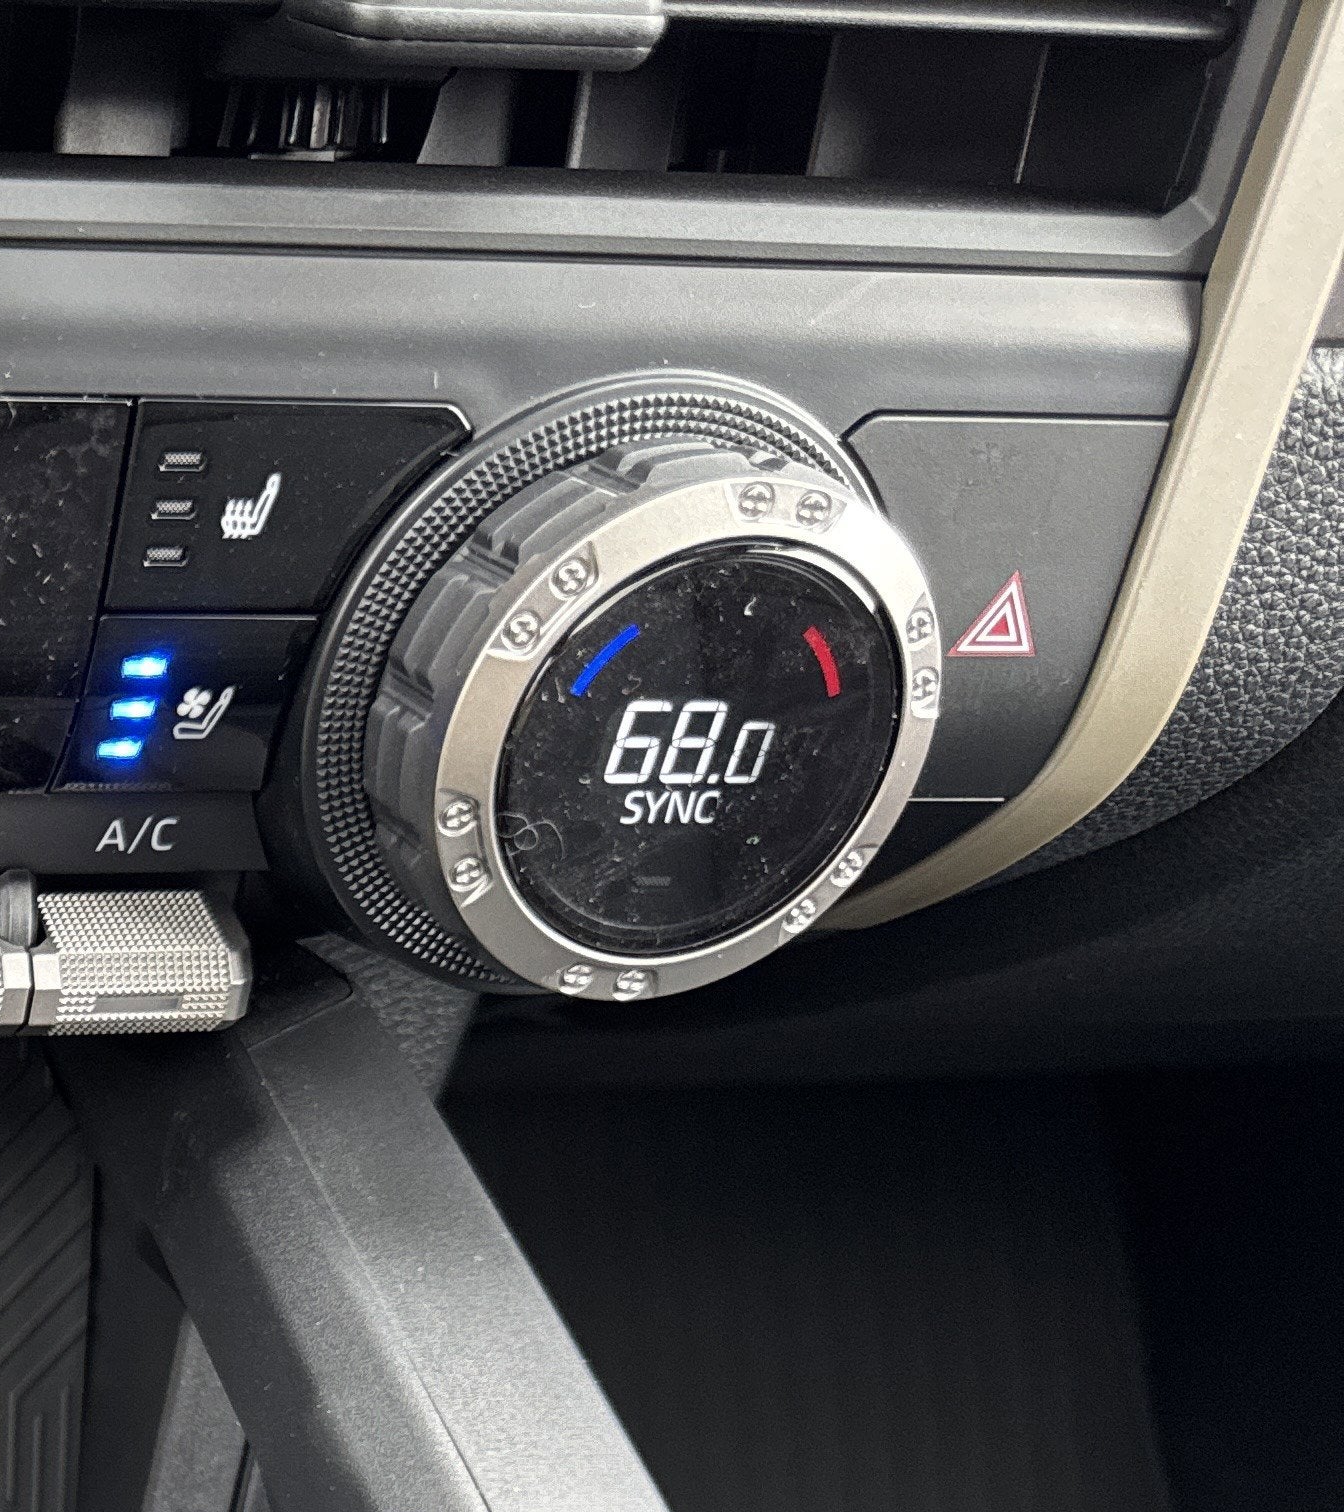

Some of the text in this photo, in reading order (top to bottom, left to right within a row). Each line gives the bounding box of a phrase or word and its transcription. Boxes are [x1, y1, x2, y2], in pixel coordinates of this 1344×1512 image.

[603, 700, 776, 784] 68.0
[619, 790, 722, 825] SYNC
[96, 814, 178, 853] A/C
